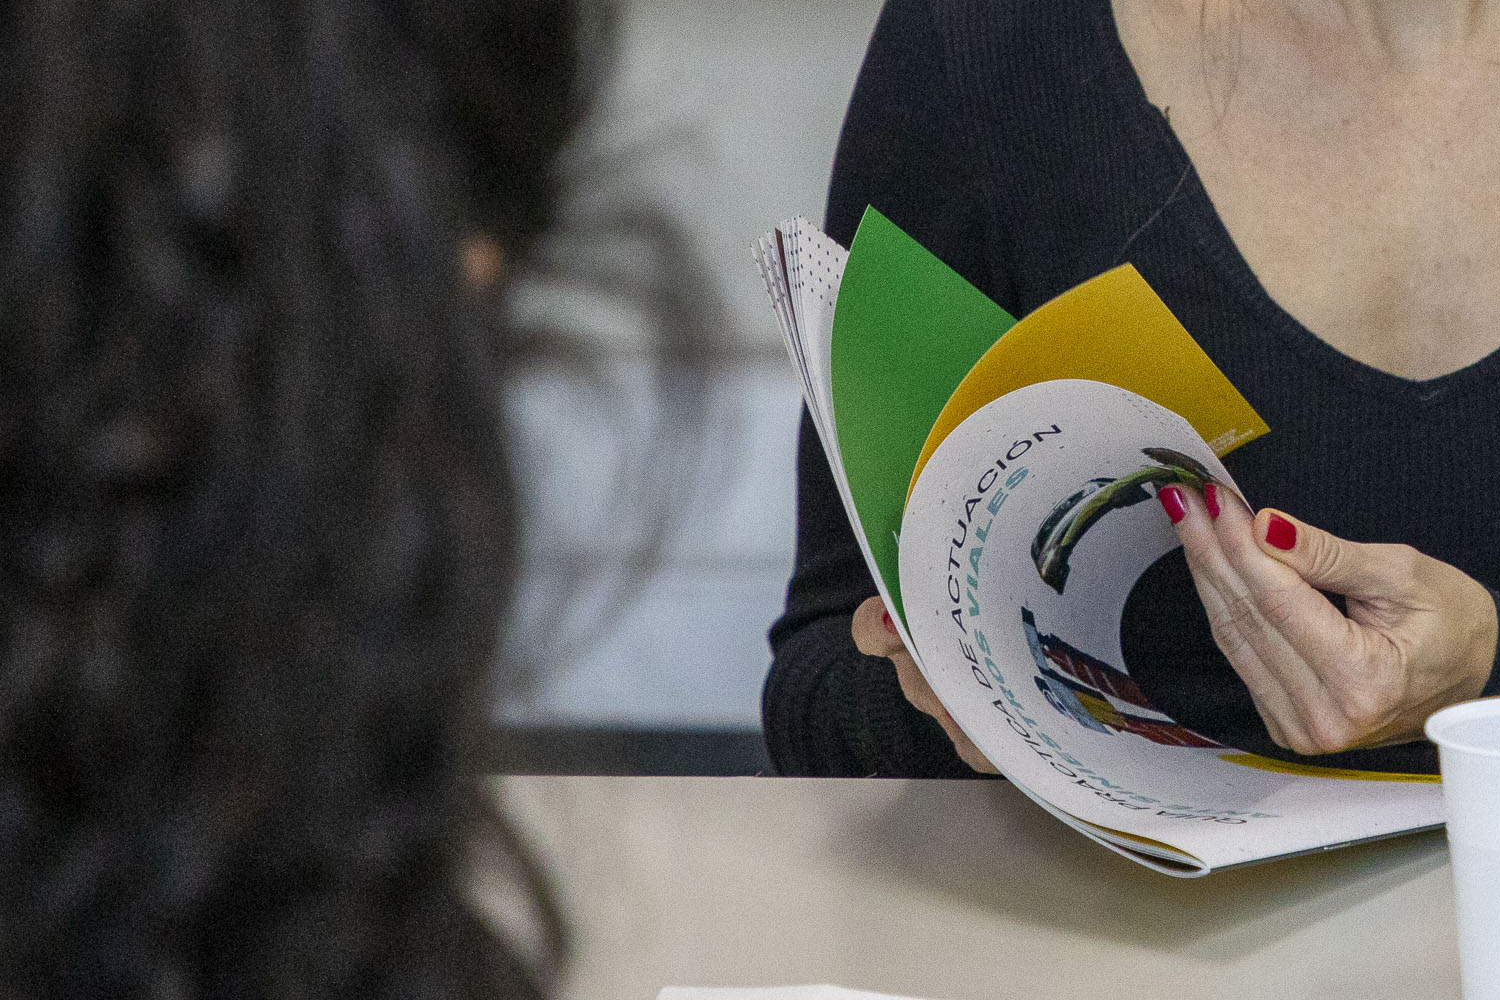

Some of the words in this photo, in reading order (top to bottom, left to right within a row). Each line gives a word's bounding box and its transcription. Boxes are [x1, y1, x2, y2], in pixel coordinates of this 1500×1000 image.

[947, 423, 1063, 635] ACTUACIÓN
[966, 465, 1029, 617] VIALES
[959, 638, 994, 690] DE
[974, 628, 1161, 804] SINIESTROS
